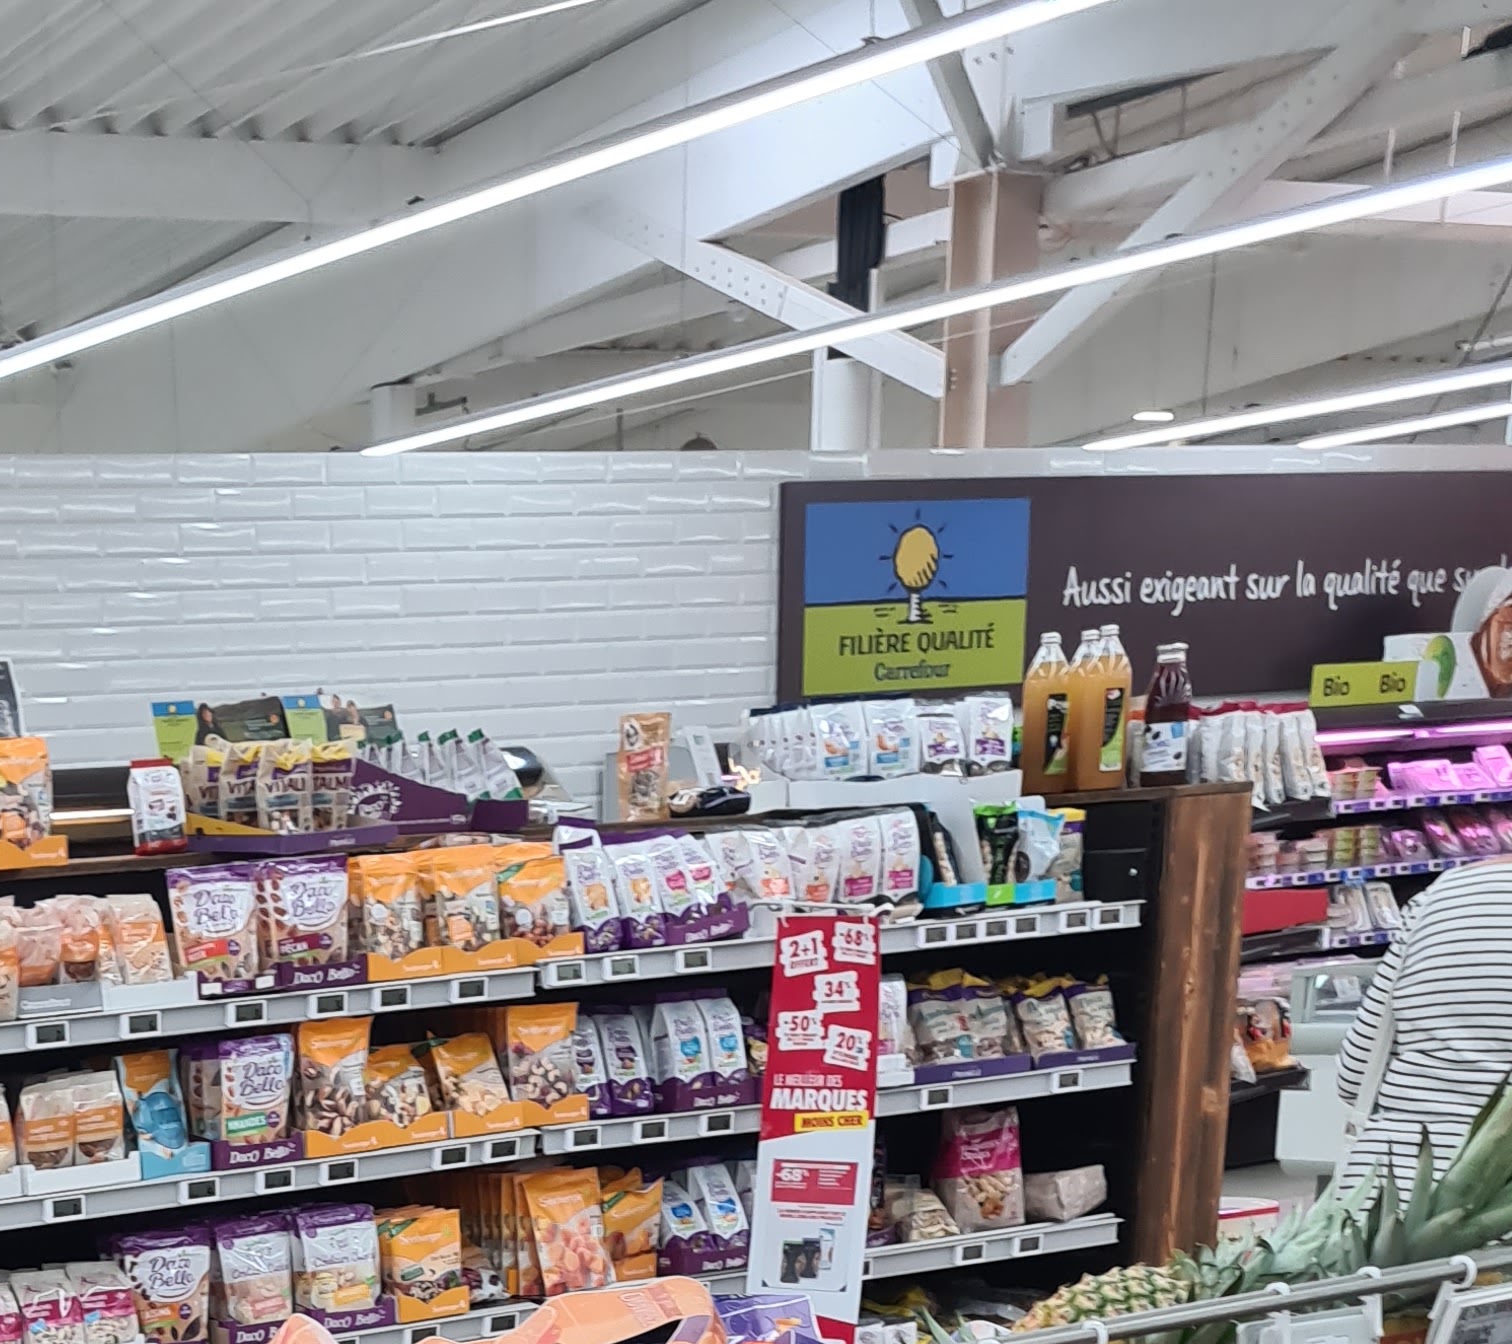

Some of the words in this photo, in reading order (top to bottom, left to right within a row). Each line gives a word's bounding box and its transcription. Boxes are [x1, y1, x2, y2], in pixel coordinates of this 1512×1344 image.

[1062, 565, 1133, 607] Aussi
[1139, 563, 1240, 617] exigeant
[1245, 565, 1289, 600] sur
[1295, 558, 1316, 597] la
[1323, 557, 1402, 610] qualité
[1406, 568, 1448, 608] que
[838, 627, 910, 657] FILIÈRE
[917, 623, 996, 650] QUALITÉ
[1378, 672, 1407, 694] Bio
[769, 1087, 869, 1112] MARQUES
